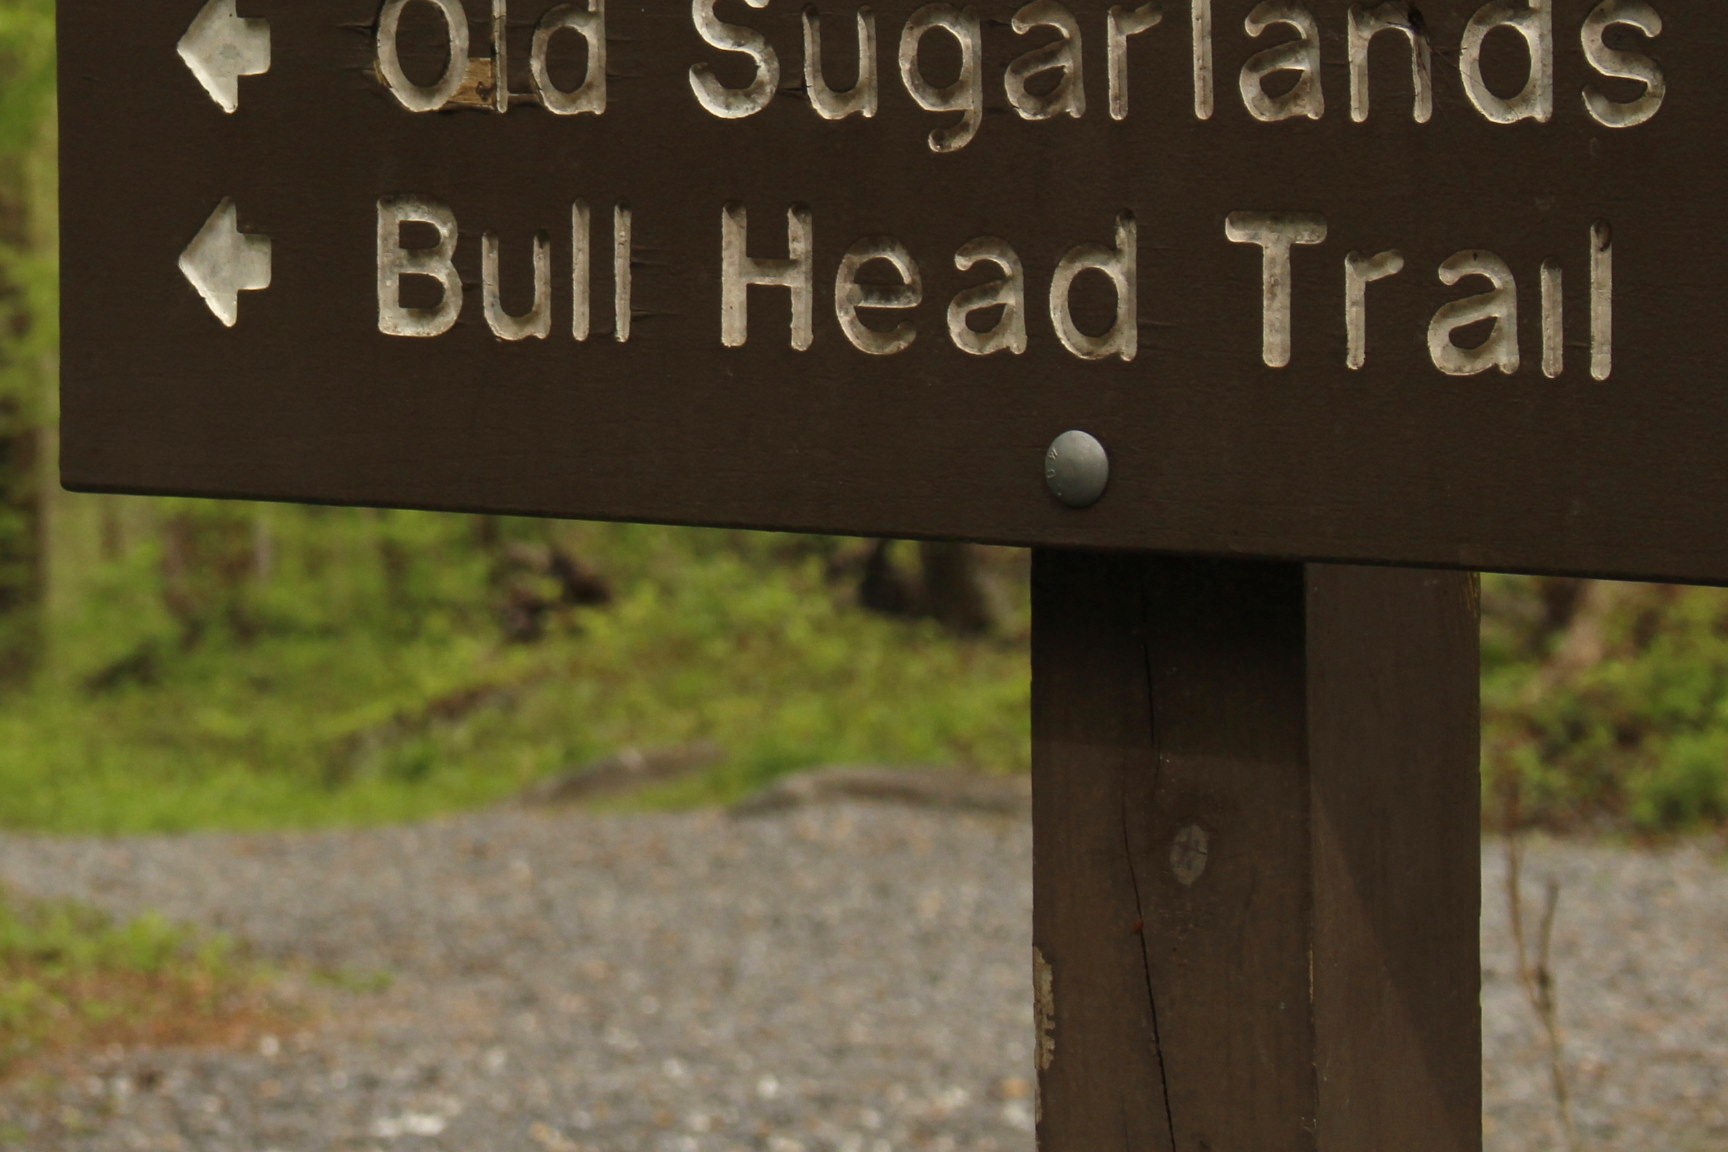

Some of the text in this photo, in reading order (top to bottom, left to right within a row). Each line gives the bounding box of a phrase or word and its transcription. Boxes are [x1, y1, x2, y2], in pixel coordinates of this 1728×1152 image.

[376, 192, 1614, 382] Bull Head Trail
